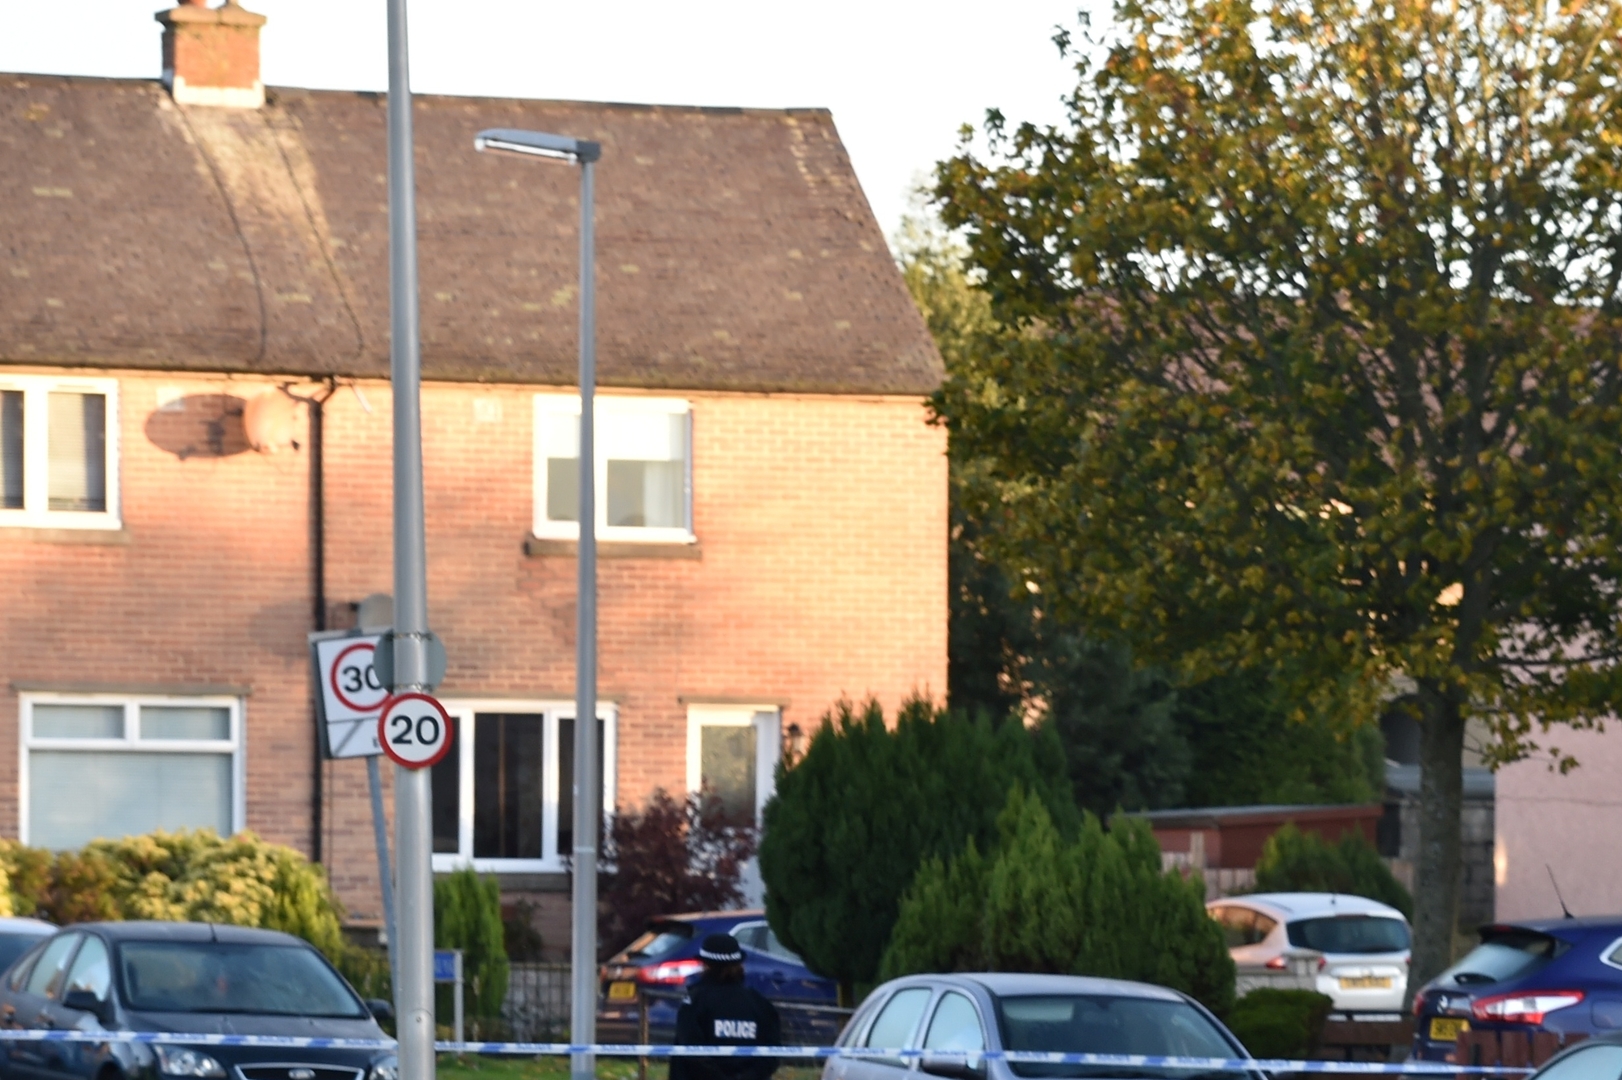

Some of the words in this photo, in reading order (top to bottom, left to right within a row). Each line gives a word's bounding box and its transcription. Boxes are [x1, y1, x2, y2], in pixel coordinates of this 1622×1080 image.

[342, 665, 384, 693] 30
[391, 715, 440, 745] 20
[714, 1019, 757, 1039] POLICE
